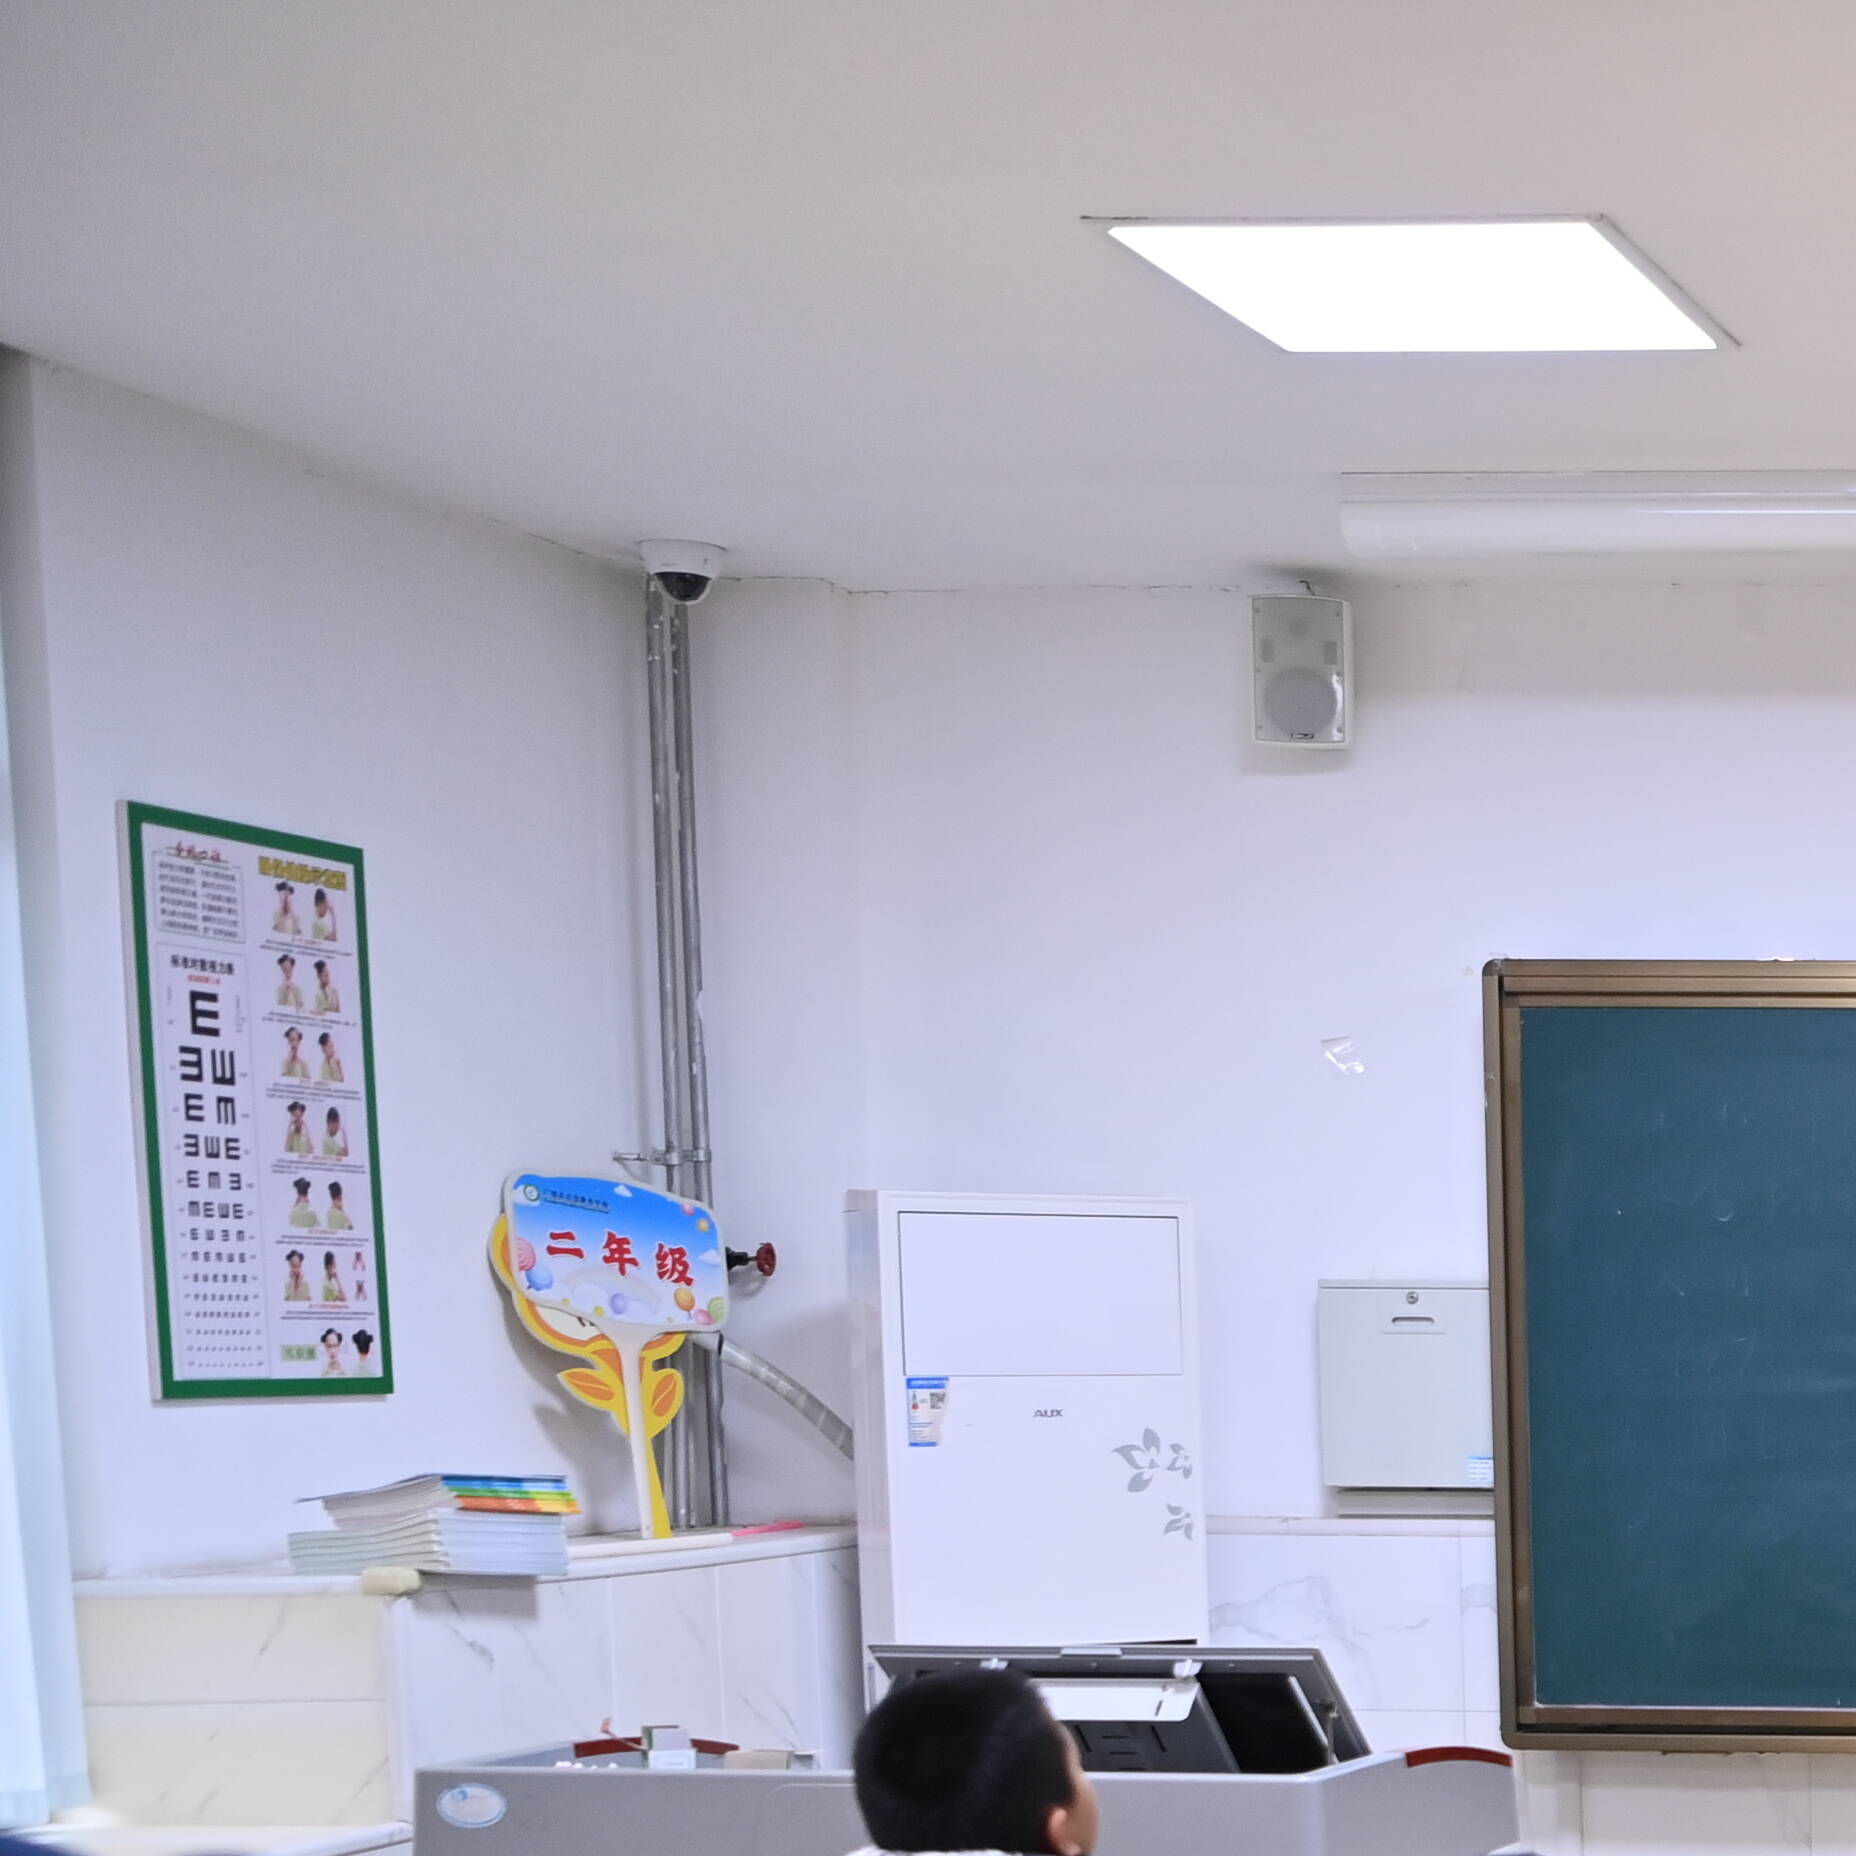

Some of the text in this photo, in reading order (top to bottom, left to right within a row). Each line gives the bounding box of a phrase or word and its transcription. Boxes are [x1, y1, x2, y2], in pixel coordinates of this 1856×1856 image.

[545, 1230, 696, 1287] 二年级
[1033, 1409, 1064, 1418] AUX
